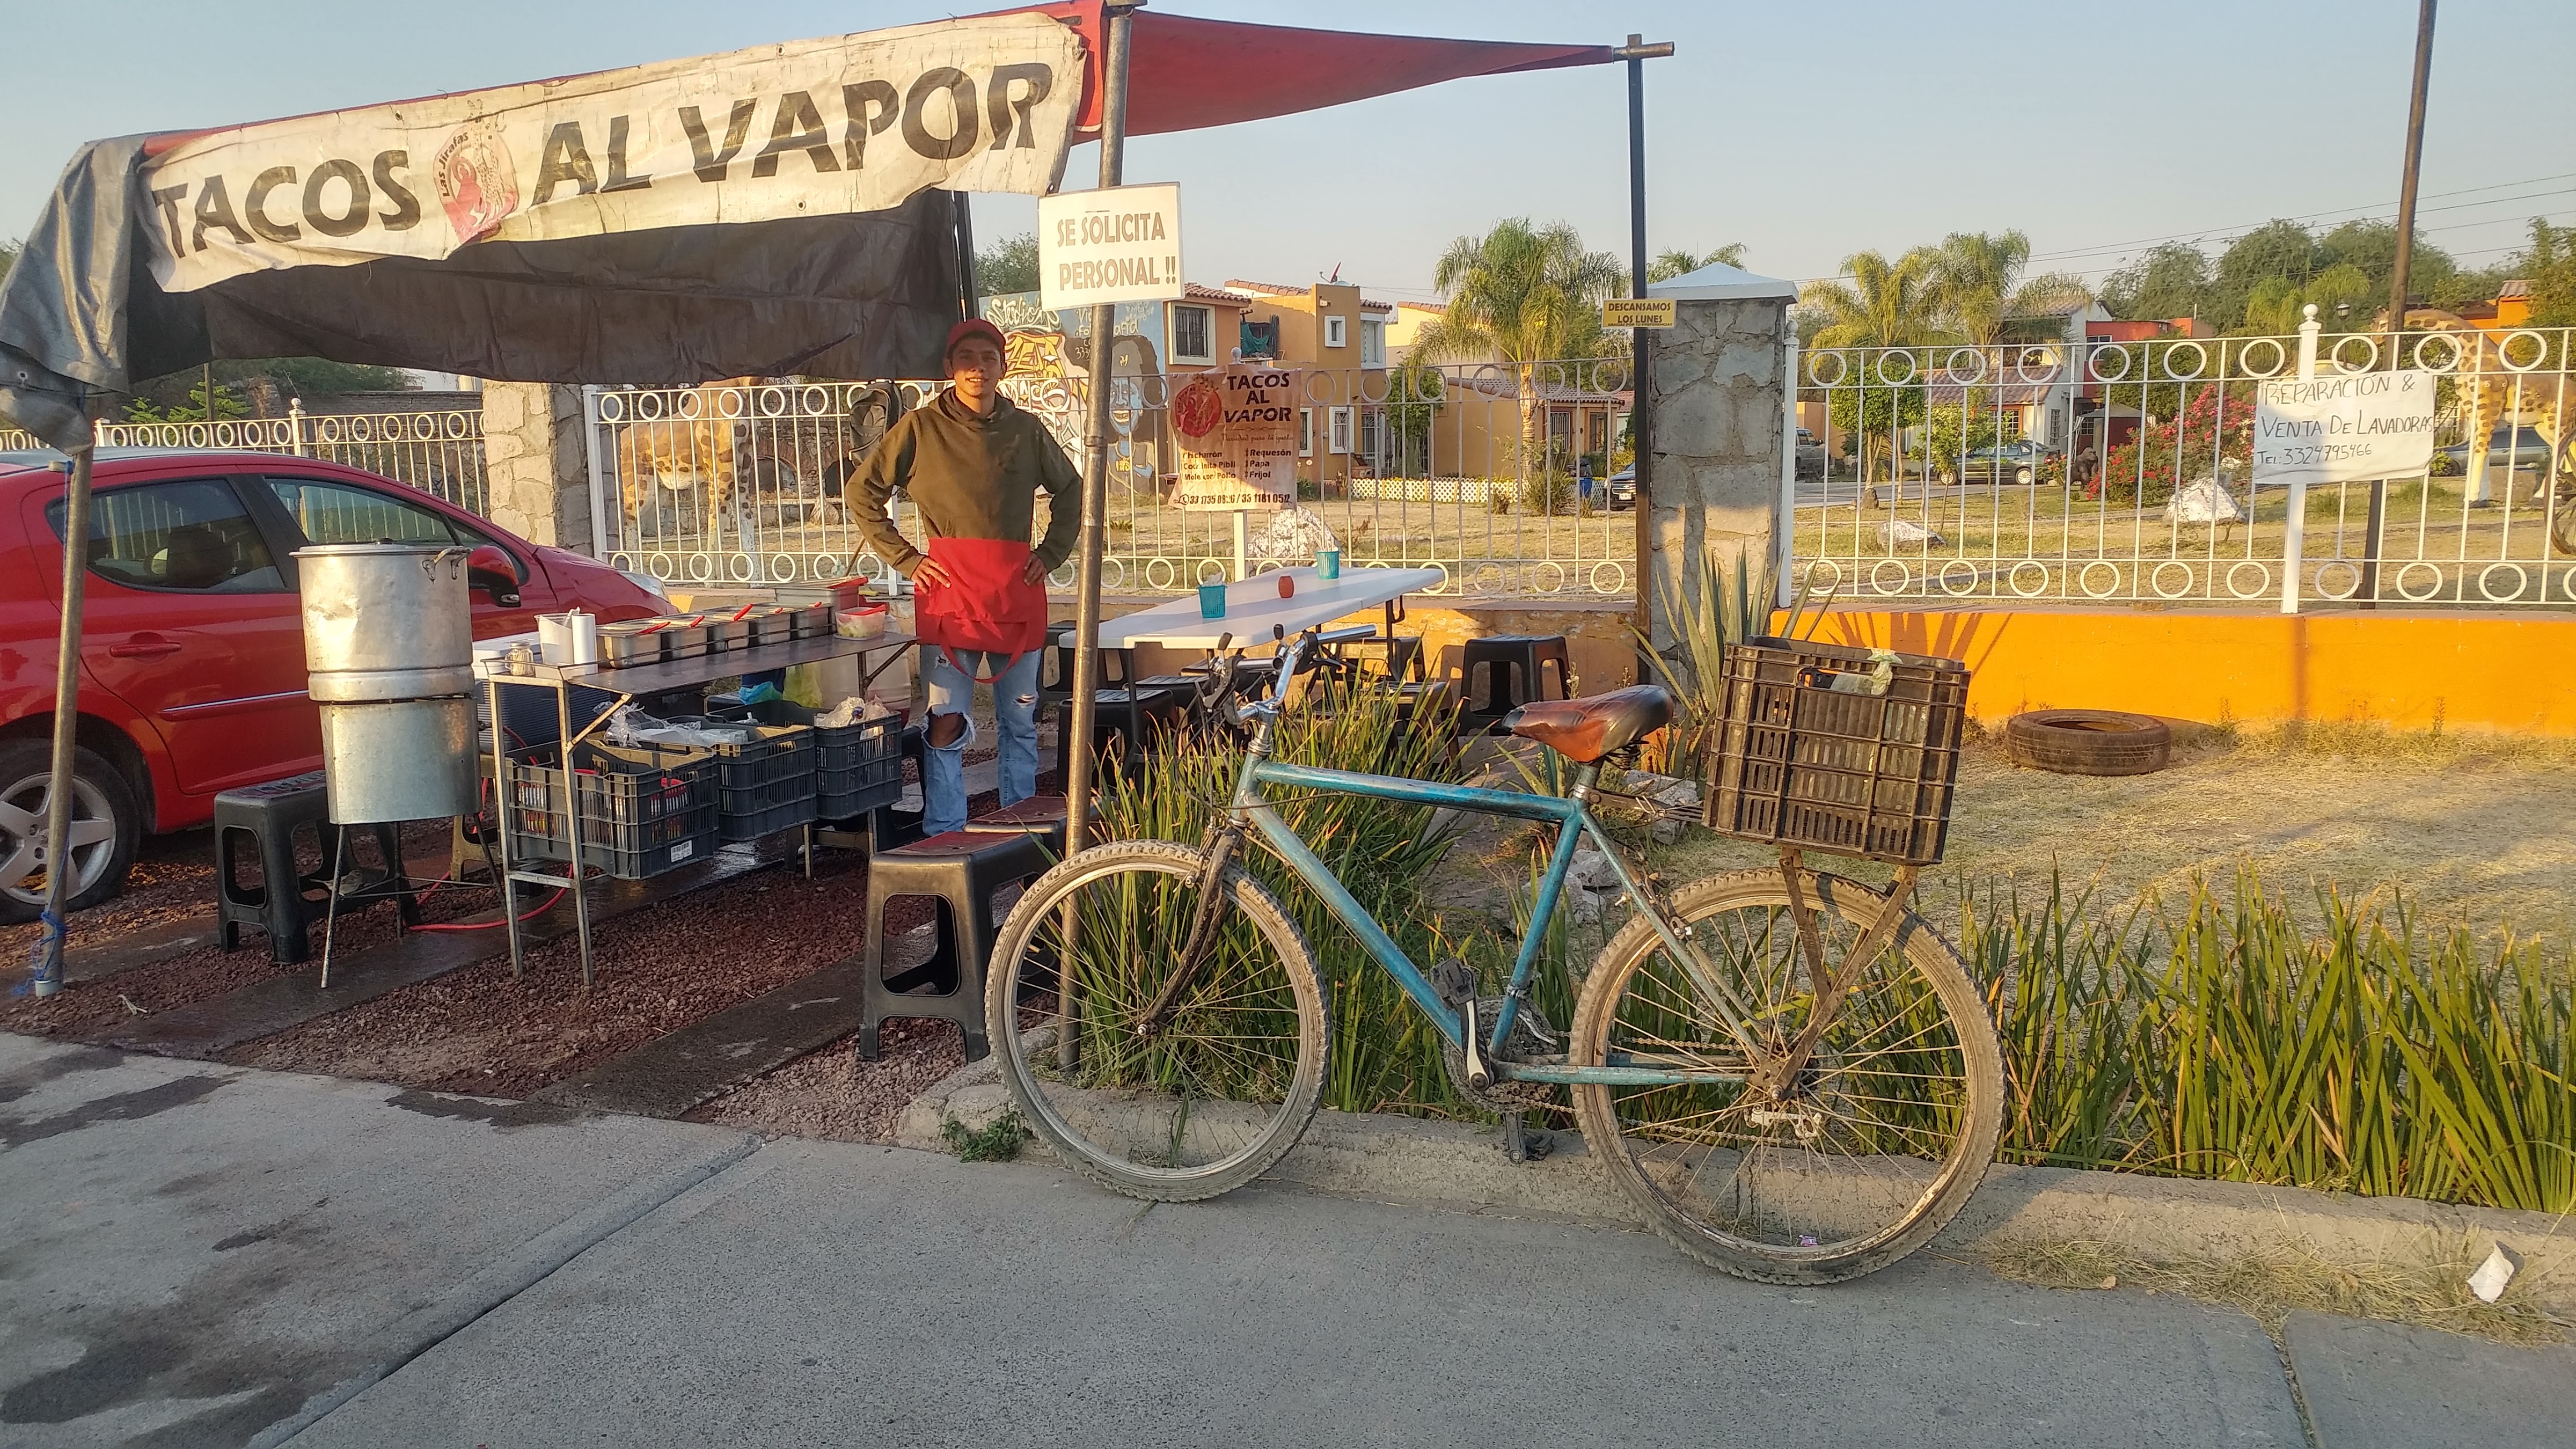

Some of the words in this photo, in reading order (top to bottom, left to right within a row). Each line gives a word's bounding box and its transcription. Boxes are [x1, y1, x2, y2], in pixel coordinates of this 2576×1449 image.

[438, 132, 469, 170] Jirafas
[151, 149, 421, 259] TACOS
[533, 115, 654, 206] AL
[675, 62, 1054, 184] VAPOR
[438, 171, 450, 197] Las
[1057, 218, 1075, 247] SE
[1081, 212, 1166, 245] SOLICITA
[1059, 257, 1160, 290] PERSONAL
[1608, 303, 1671, 311] DESCANSAMOS
[1618, 315, 1633, 323] LOS
[1227, 372, 1290, 390] TACOS
[1246, 390, 1270, 405] AL
[2264, 374, 2390, 406] REPARACIÓN
[2402, 374, 2415, 392] &
[1224, 407, 1291, 423] VAPOR
[2261, 416, 2322, 438] VENTA
[2357, 409, 2434, 435] LAVADORAS
[1276, 434, 1293, 443] gusto
[1250, 449, 1291, 458] Requesón
[2283, 443, 2372, 465] 3324795466
[1183, 462, 1217, 470] Cocinita
[1250, 460, 1270, 469] Papa
[1249, 471, 1271, 480] Frijol
[1190, 495, 1199, 504] 33
[1201, 495, 1216, 504] 1735
[1254, 493, 1270, 503] 1181
[1272, 493, 1290, 503] 0512
